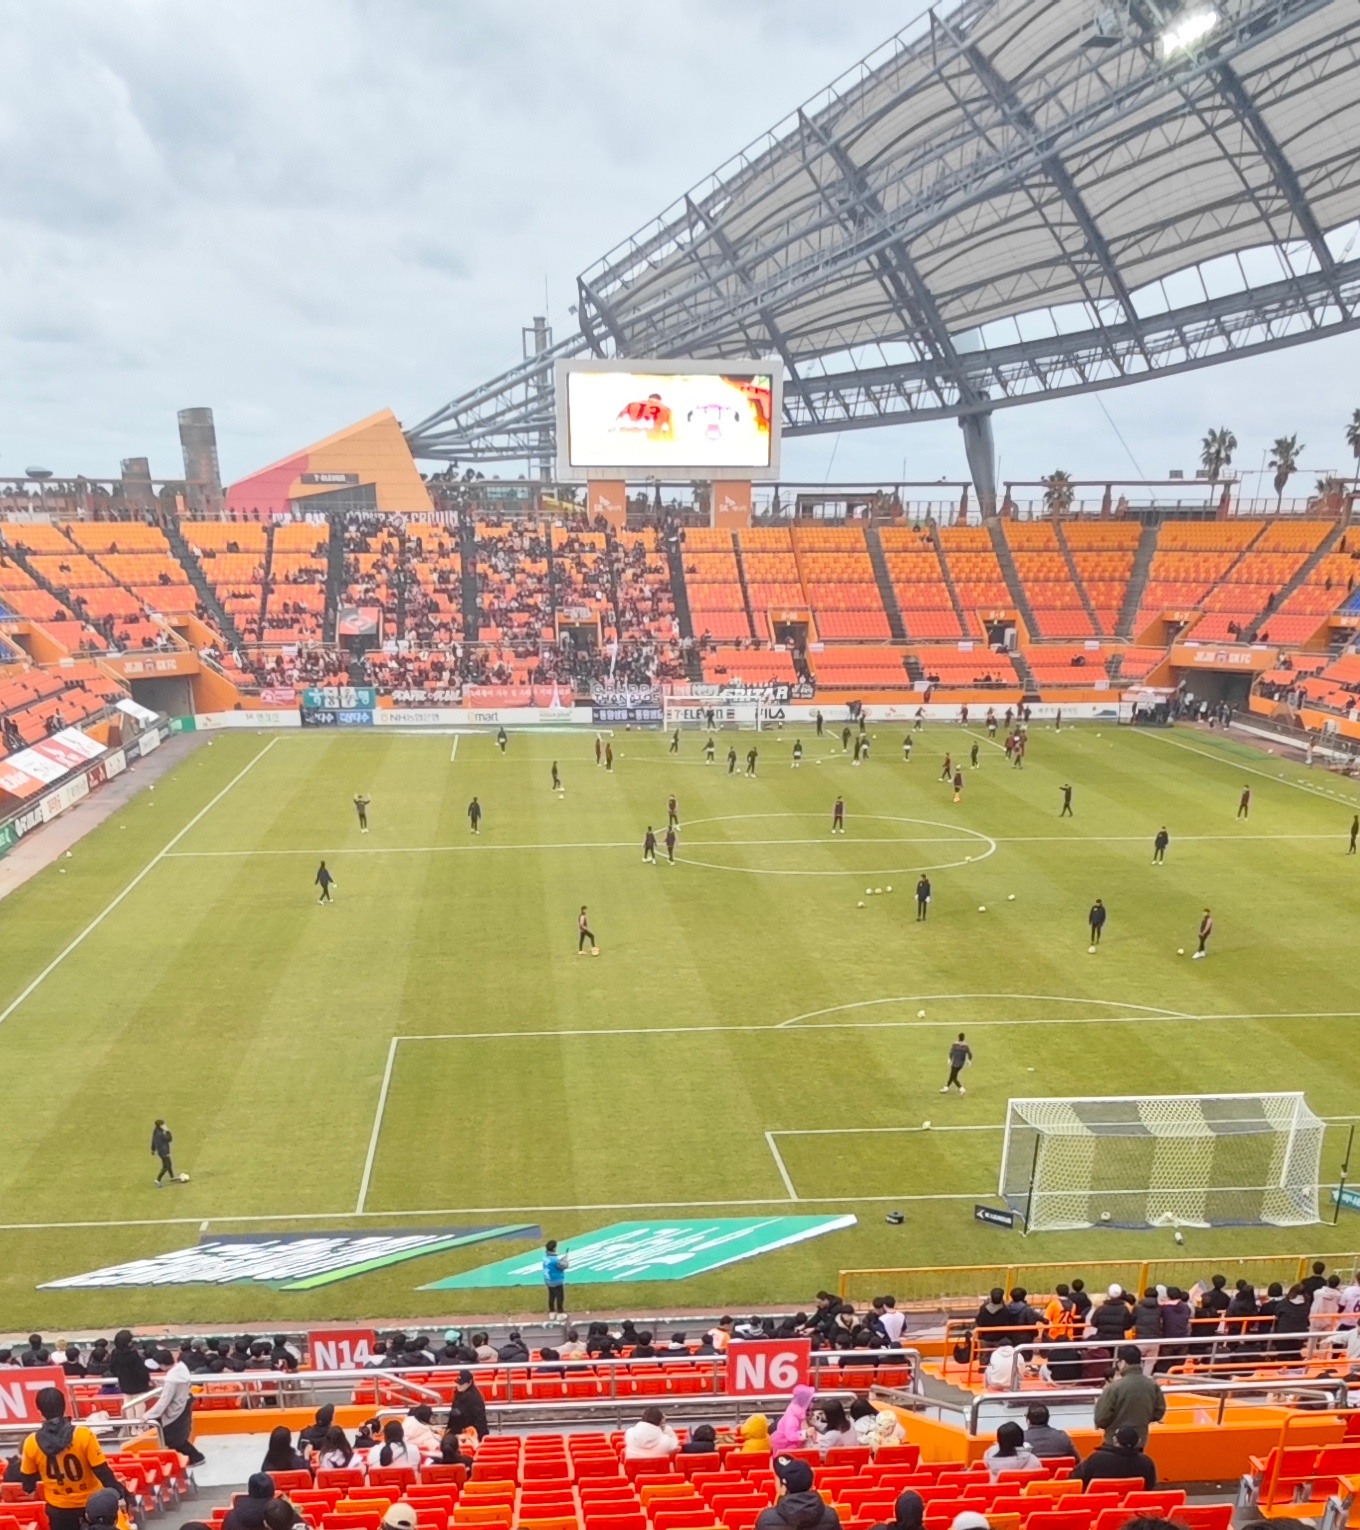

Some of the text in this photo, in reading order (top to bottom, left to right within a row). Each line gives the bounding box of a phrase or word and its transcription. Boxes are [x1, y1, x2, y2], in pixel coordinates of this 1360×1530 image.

[467, 711, 499, 723] emart
[314, 1336, 374, 1370] N14
[734, 1351, 798, 1391] N6
[46, 1453, 84, 1482] 40
